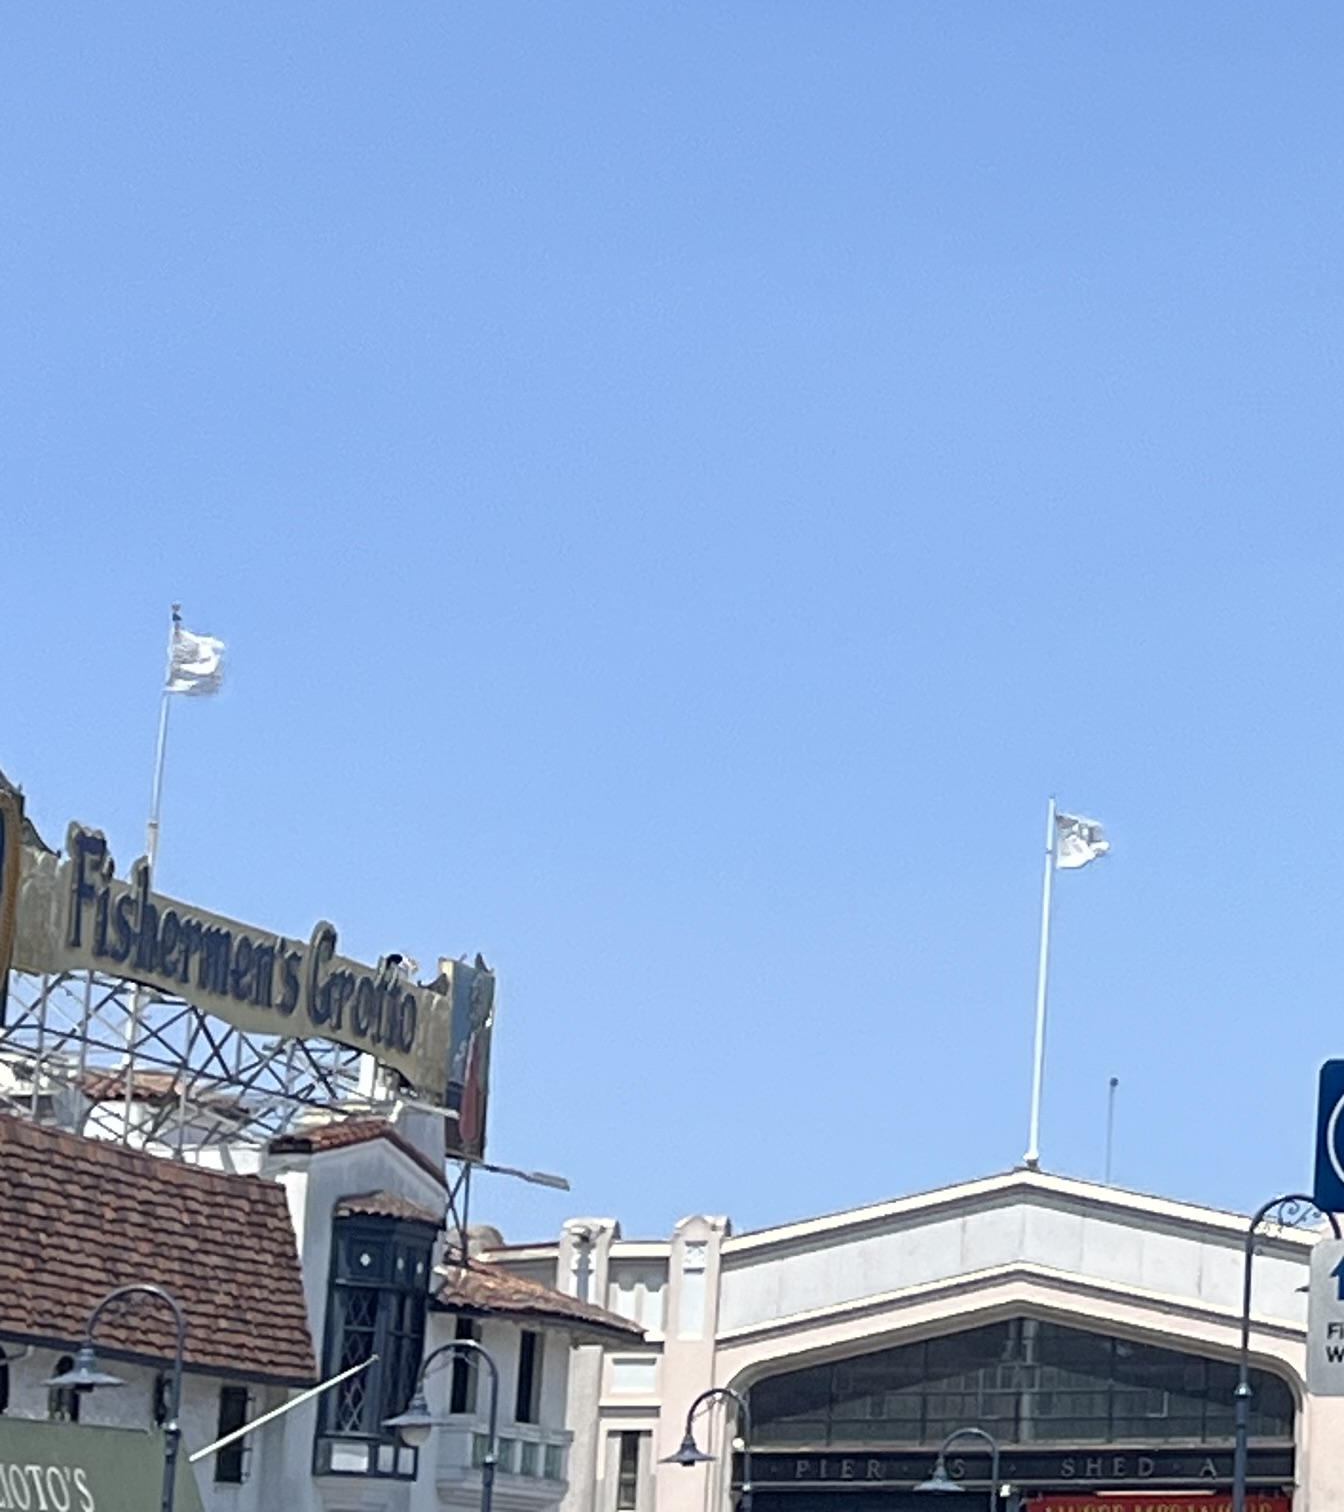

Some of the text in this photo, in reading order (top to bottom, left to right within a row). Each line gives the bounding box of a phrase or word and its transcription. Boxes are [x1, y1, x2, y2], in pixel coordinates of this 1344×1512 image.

[67, 822, 419, 1055] Fishermen's Grotto
[795, 1458, 883, 1479] PIER
[1060, 1457, 1155, 1478] SHED
[1200, 1457, 1218, 1480] A
